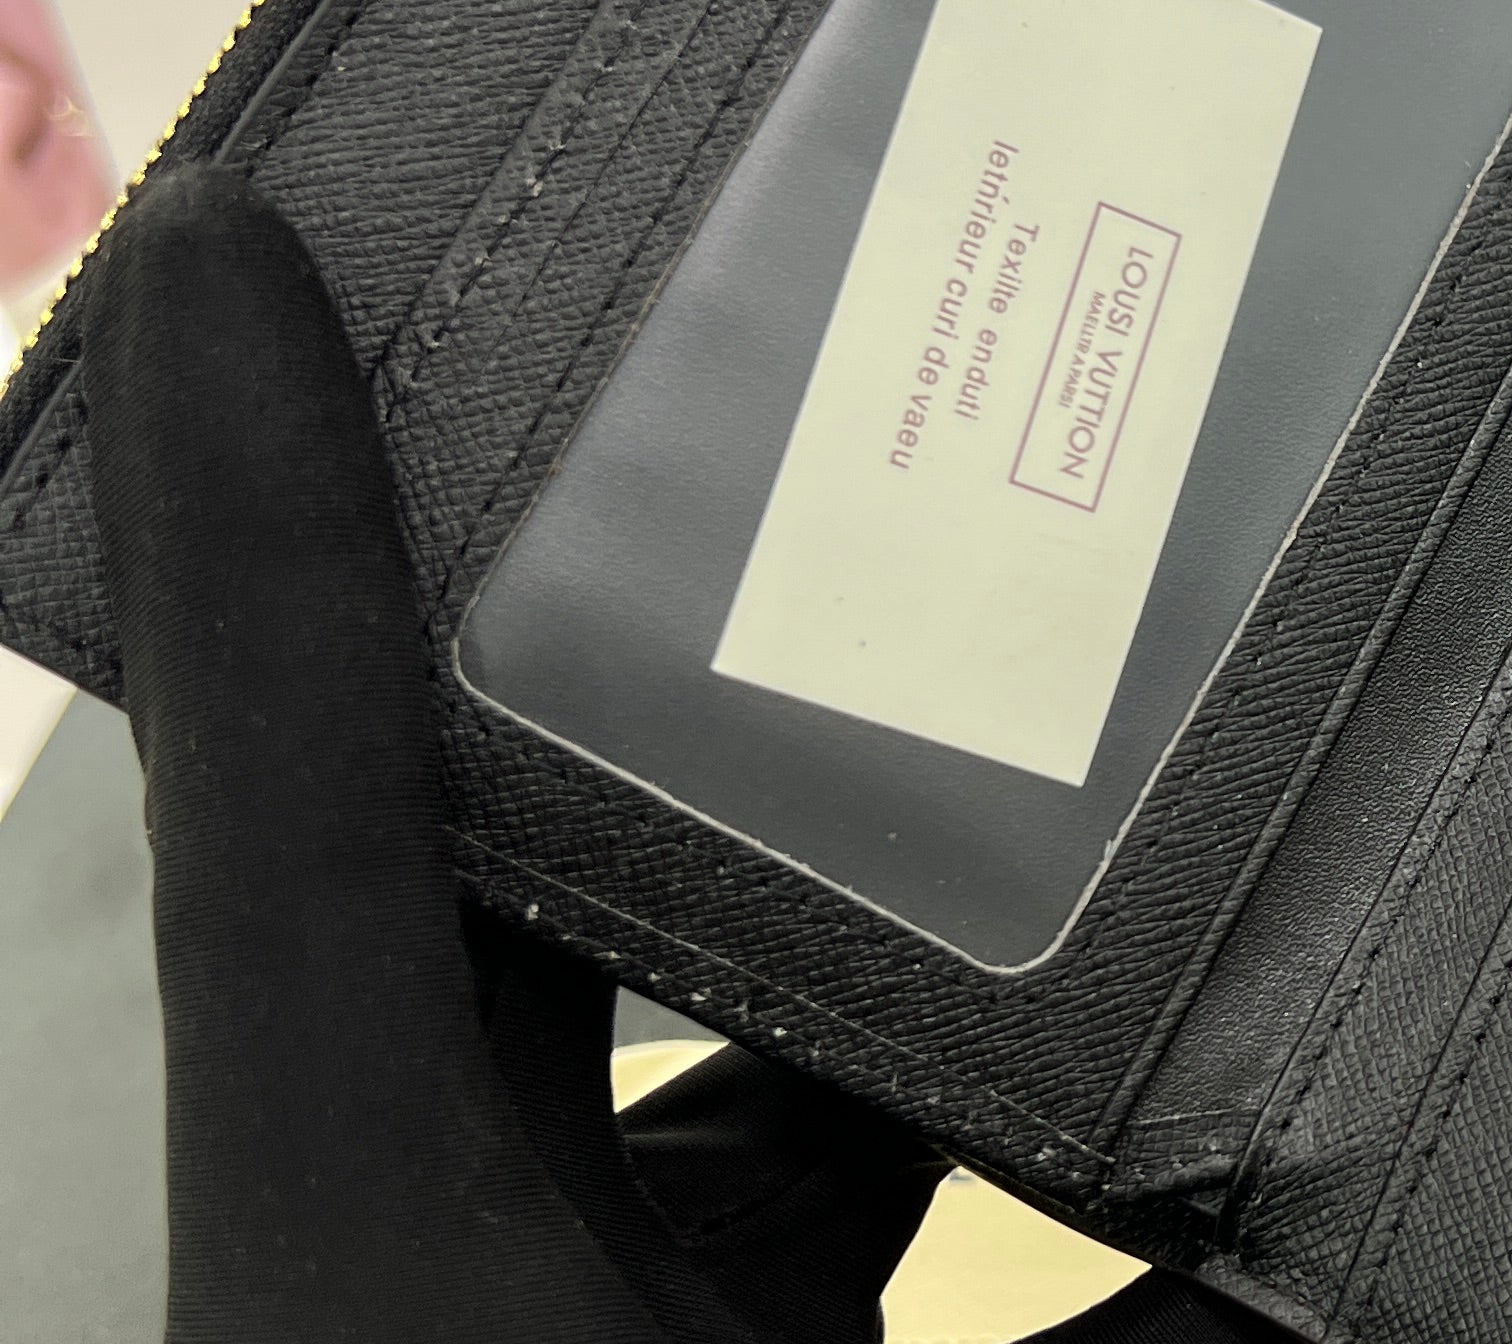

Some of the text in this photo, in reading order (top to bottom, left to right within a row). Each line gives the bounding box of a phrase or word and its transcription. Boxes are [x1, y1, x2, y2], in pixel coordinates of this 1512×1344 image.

[931, 278, 968, 340] curi
[953, 224, 1040, 420] Texilte enduti
[916, 346, 950, 386] de
[1057, 246, 1154, 479] LOUSI VUTTION
[1058, 367, 1083, 408] PARSI
[888, 395, 931, 472] vaeu
